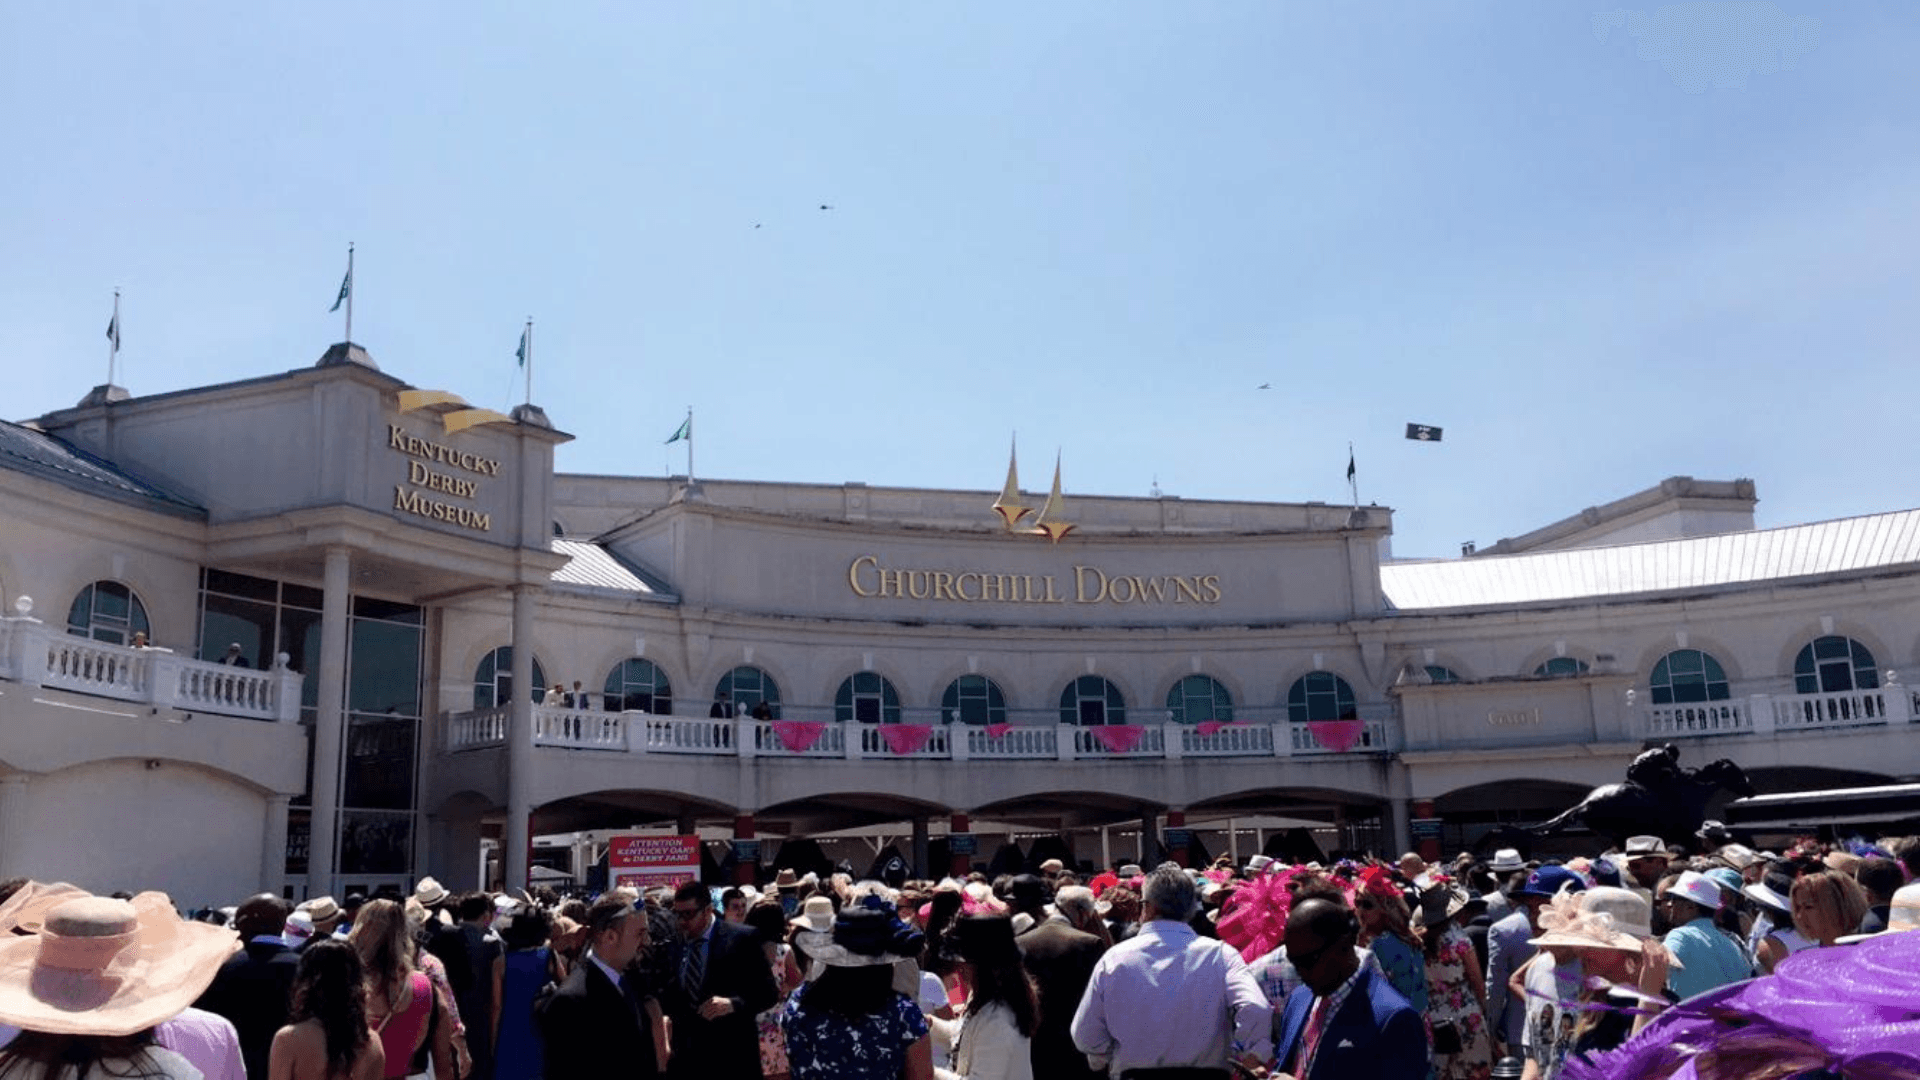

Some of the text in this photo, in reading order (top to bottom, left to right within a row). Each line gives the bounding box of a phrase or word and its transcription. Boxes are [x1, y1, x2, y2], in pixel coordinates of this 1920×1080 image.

[389, 424, 501, 475] KENTUCKY
[409, 460, 478, 498] DERBY
[395, 485, 490, 530] MUSEUM
[849, 555, 1221, 603] CHURCHILL DOWNS
[617, 847, 669, 855] KENTUCKY
[628, 839, 683, 848] ATTENTION
